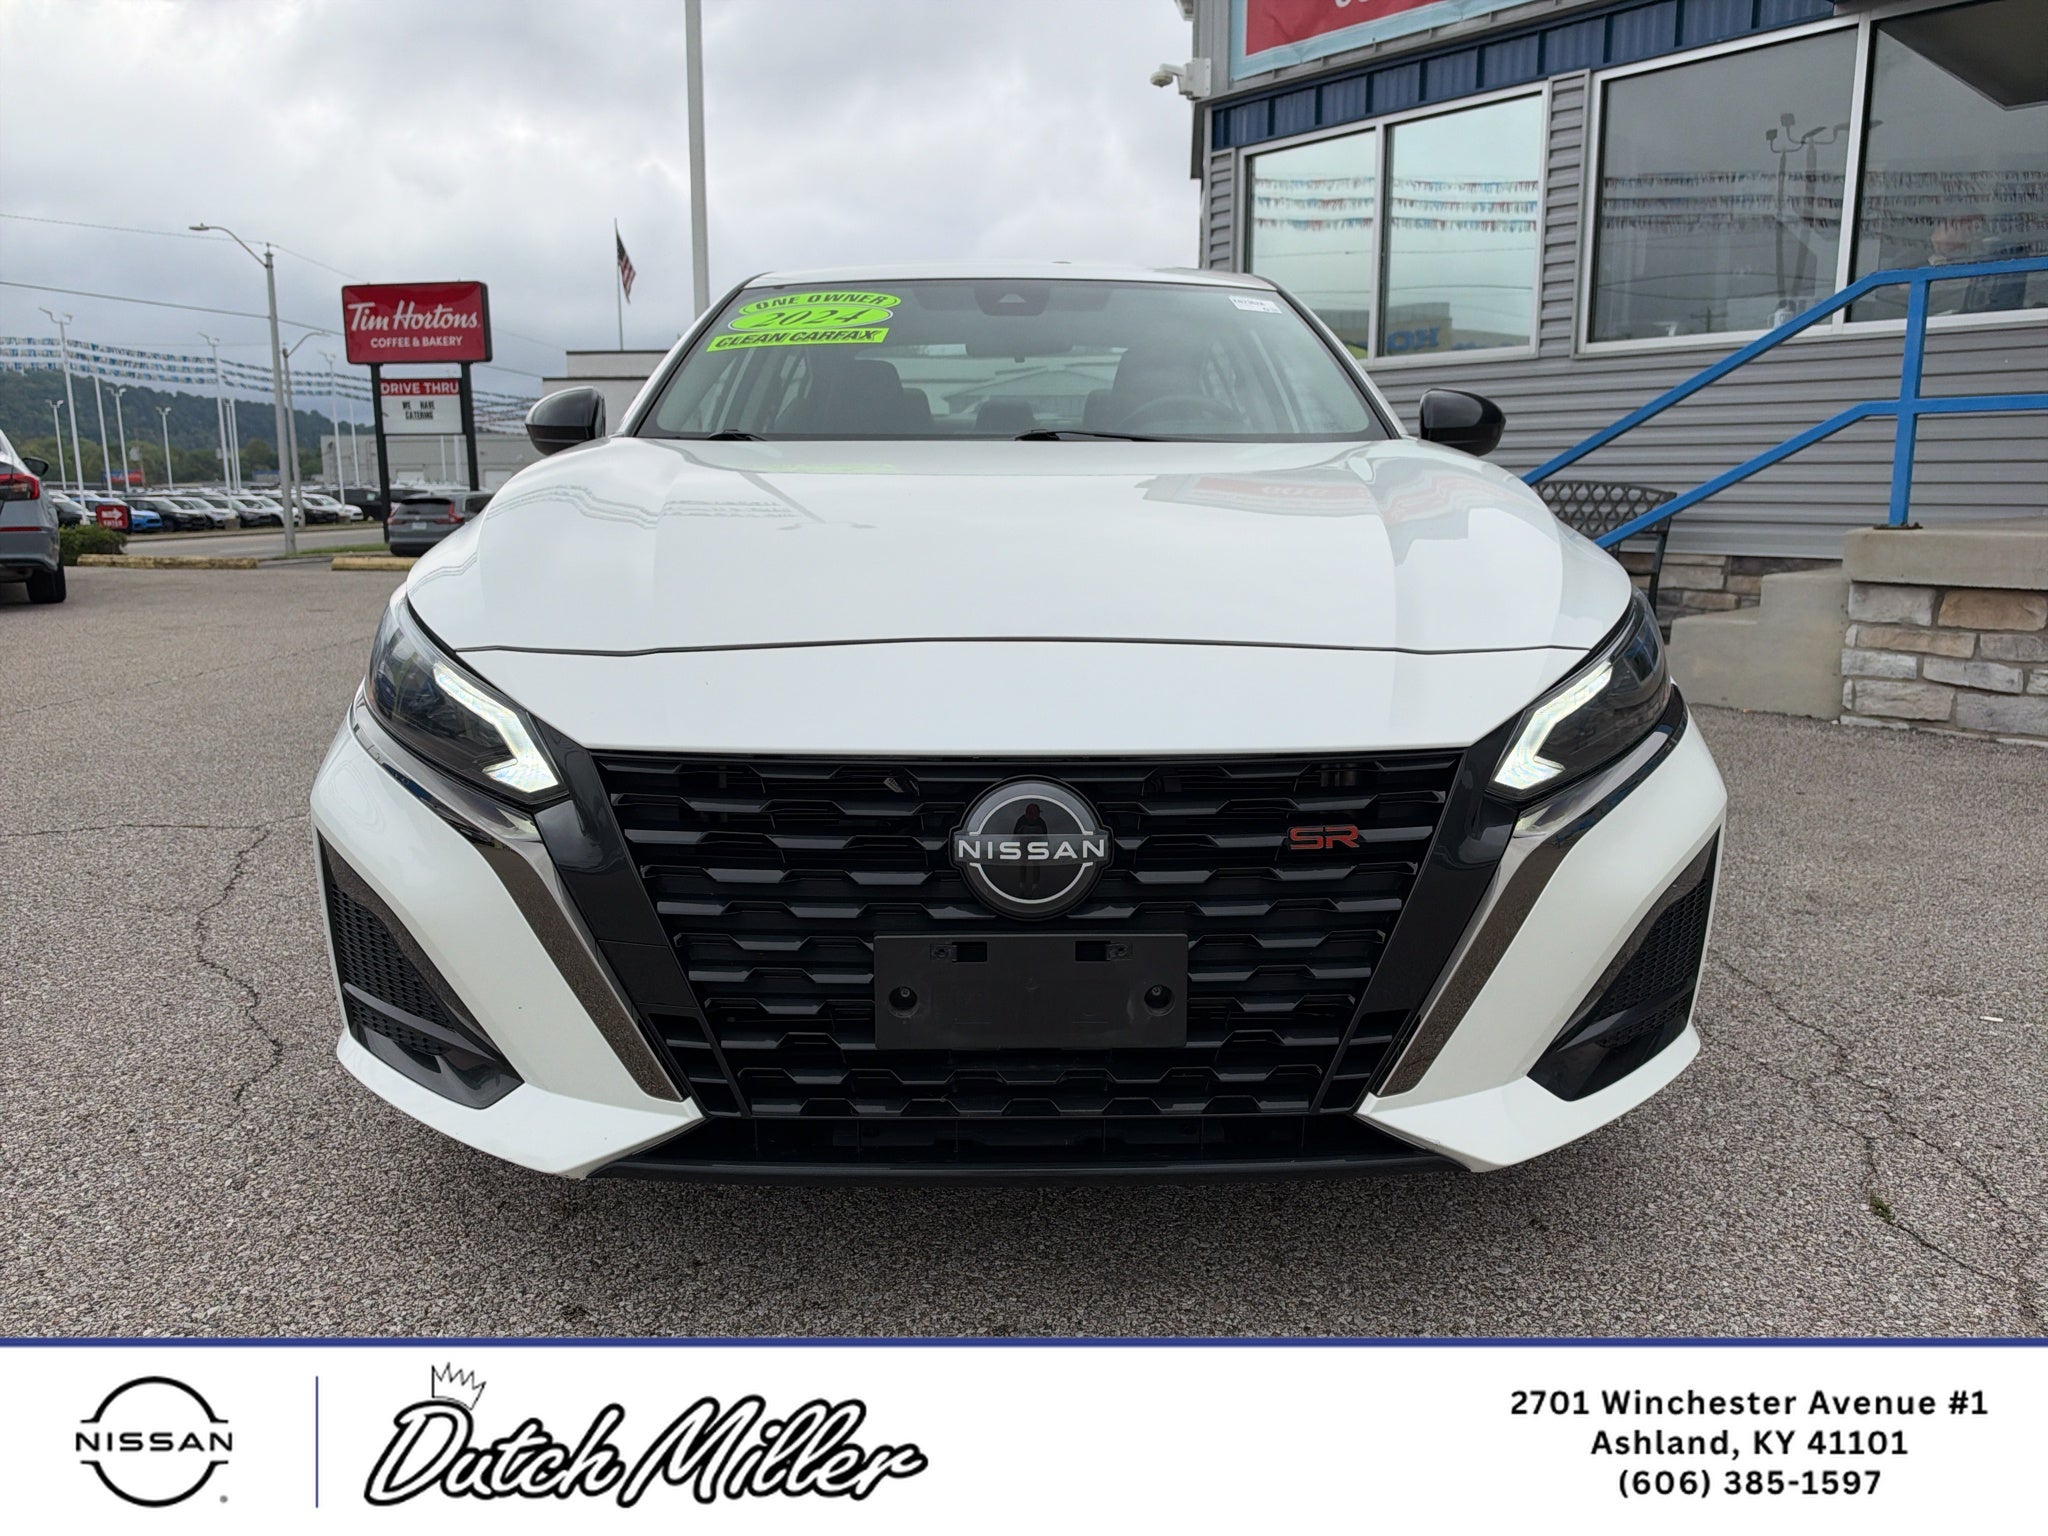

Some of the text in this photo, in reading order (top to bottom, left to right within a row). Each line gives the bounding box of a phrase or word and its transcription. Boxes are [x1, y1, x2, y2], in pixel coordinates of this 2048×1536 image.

[755, 294, 889, 310] ONE OWNER
[347, 299, 478, 331] Tim Hortons
[750, 308, 873, 328] 2024
[370, 335, 464, 349] COFFEE & BAKERY
[715, 330, 878, 348] CLEAN CARFAX
[381, 381, 459, 394] DRIVE THRU
[402, 400, 435, 410] WE HAVE
[405, 410, 434, 420] CATERING
[1289, 824, 1360, 849] SR
[958, 839, 1105, 860] NISSAN
